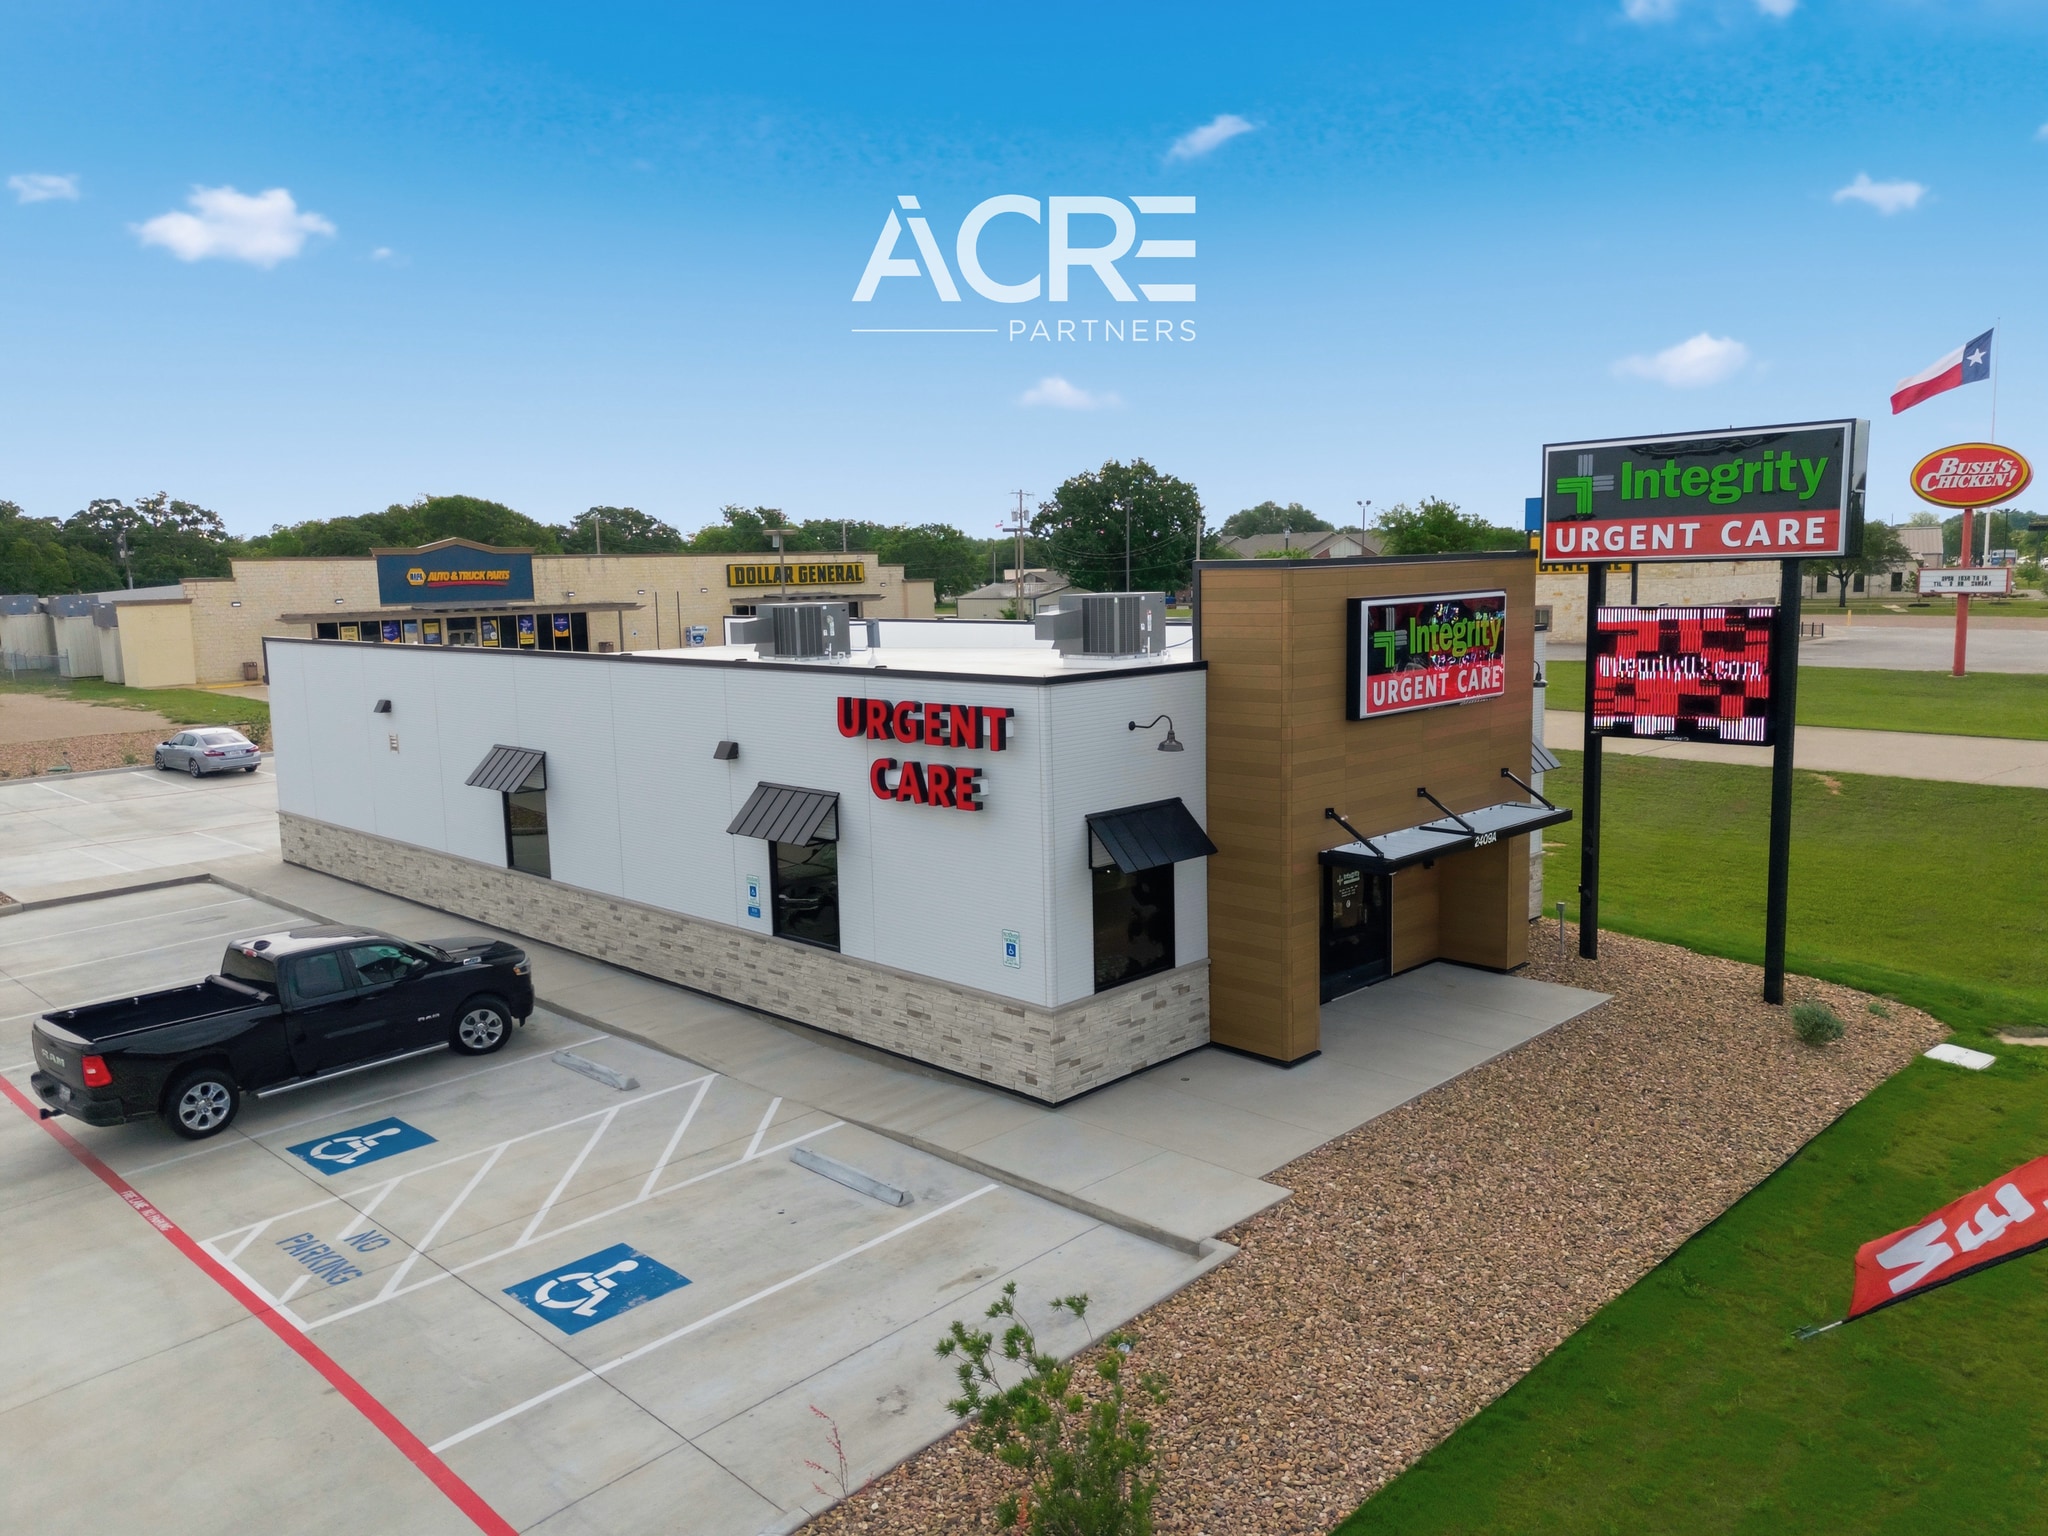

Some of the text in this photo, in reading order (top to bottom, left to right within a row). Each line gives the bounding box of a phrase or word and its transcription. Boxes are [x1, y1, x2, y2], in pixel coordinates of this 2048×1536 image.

[1621, 451, 1829, 504] Integrity
[1555, 516, 1826, 552] URGENT CARE
[428, 571, 450, 581] AUTO
[450, 571, 458, 581] &
[459, 571, 486, 581] TRUCK
[486, 570, 510, 580] PARTS
[734, 564, 862, 585] DOLLAR GENERAL
[1410, 617, 1502, 657] Integrity
[1373, 665, 1501, 706] URGENT CARE
[837, 697, 1014, 751] URGENT
[870, 757, 983, 811] CARE
[41, 1048, 65, 1068] RAM
[275, 1232, 363, 1286] PARKING
[343, 1229, 391, 1252] NO
